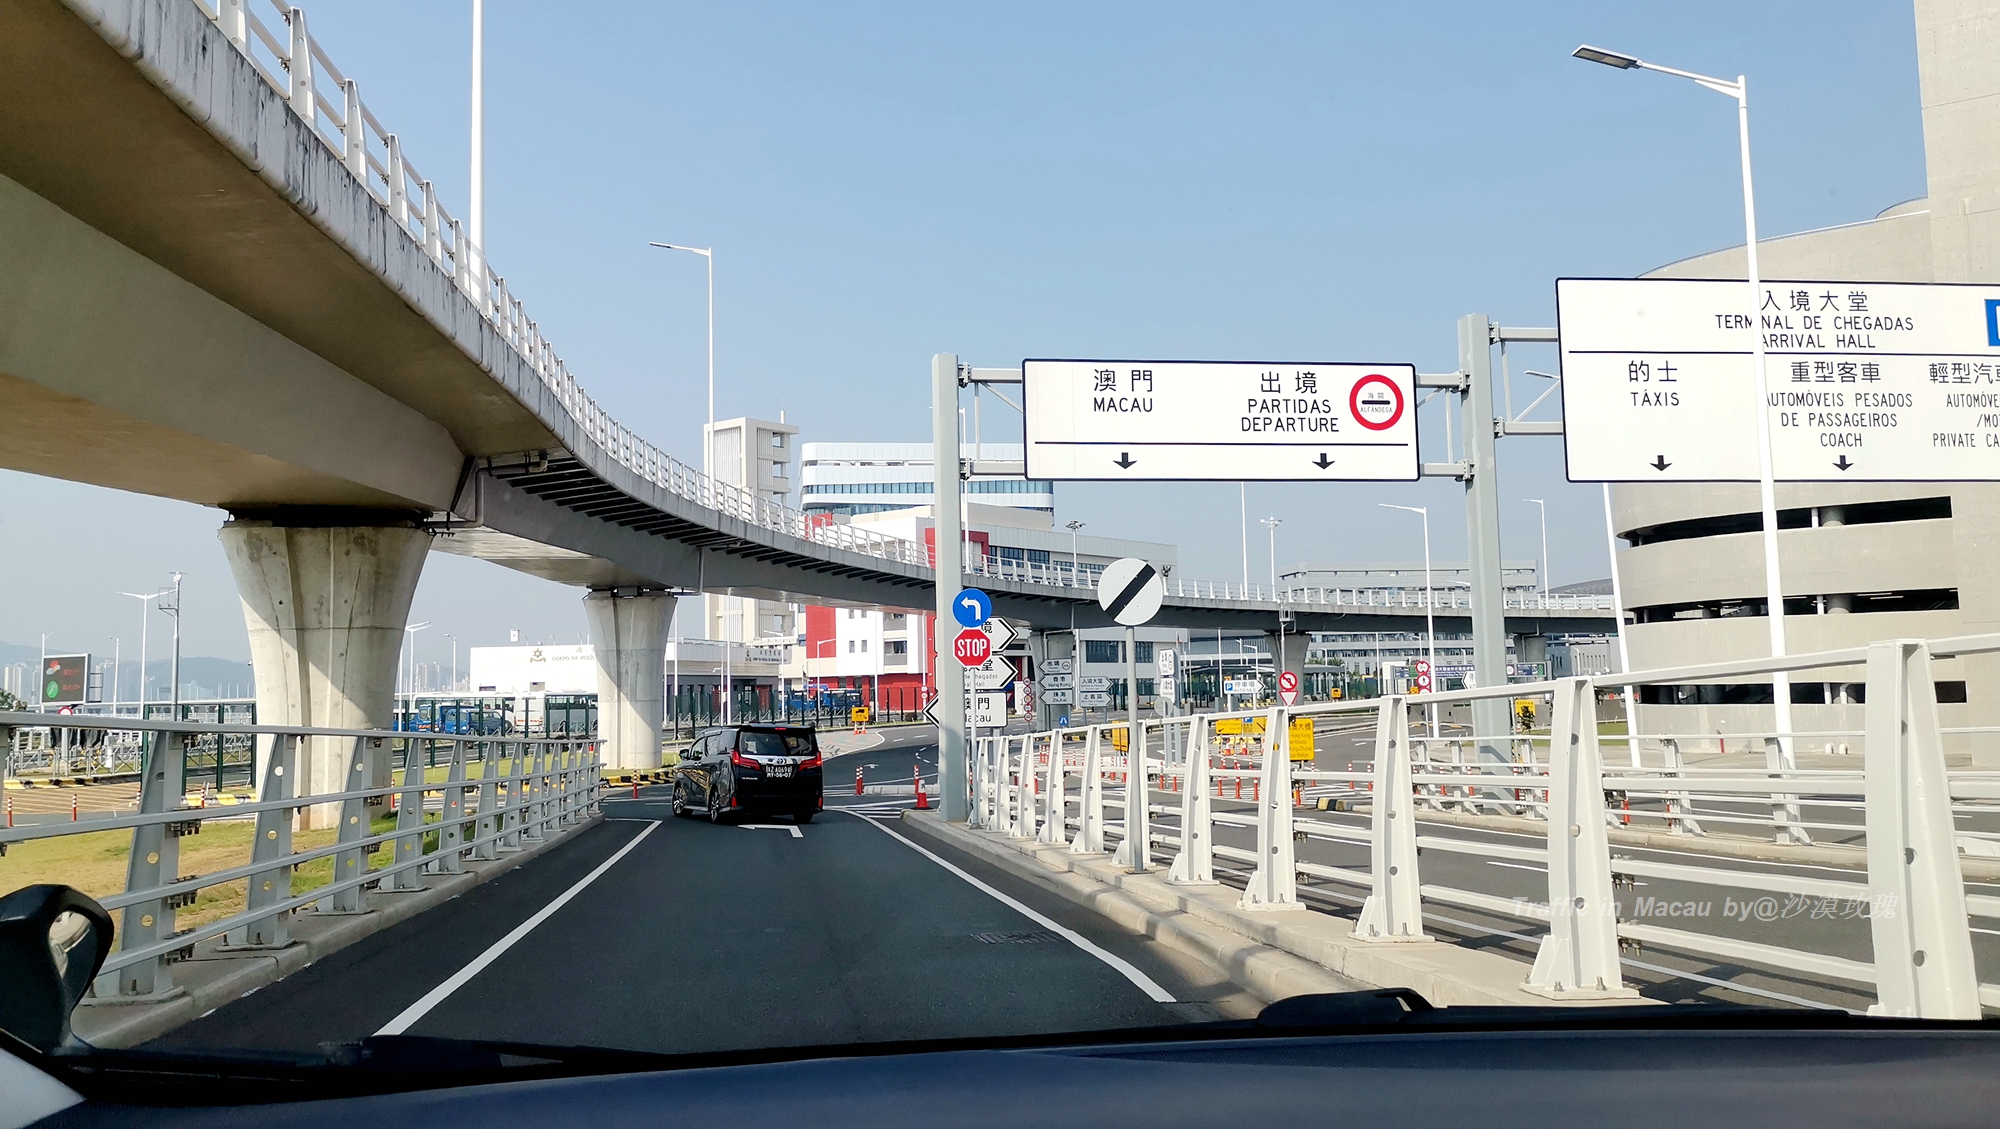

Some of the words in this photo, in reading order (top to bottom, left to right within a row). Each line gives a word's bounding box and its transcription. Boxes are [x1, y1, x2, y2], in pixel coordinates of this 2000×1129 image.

[1760, 290, 1869, 312] 入境大堂
[1715, 315, 1793, 330] TERMNAL
[1803, 316, 1822, 330] DE
[1834, 317, 1914, 331] CHEGADAS
[1836, 334, 1876, 348] HALL
[1628, 360, 1678, 383] 的士
[1790, 361, 1881, 384] 重型客車
[1093, 369, 1153, 392] 澳門
[1260, 371, 1317, 394] 出境
[1093, 397, 1154, 413] MACAU
[1630, 389, 1680, 406] TÁXIS
[1855, 393, 1913, 407] PESADOS
[1248, 398, 1332, 414] PARTIDAS
[1241, 416, 1340, 433] DEPARTURE
[1781, 413, 1799, 427] DE
[1808, 413, 1898, 428] PASSAGEIROS
[1976, 413, 2000, 428] /MO
[1820, 432, 1863, 447] COACH
[1932, 433, 1976, 448] PRIVATE
[957, 638, 987, 657] STOP
